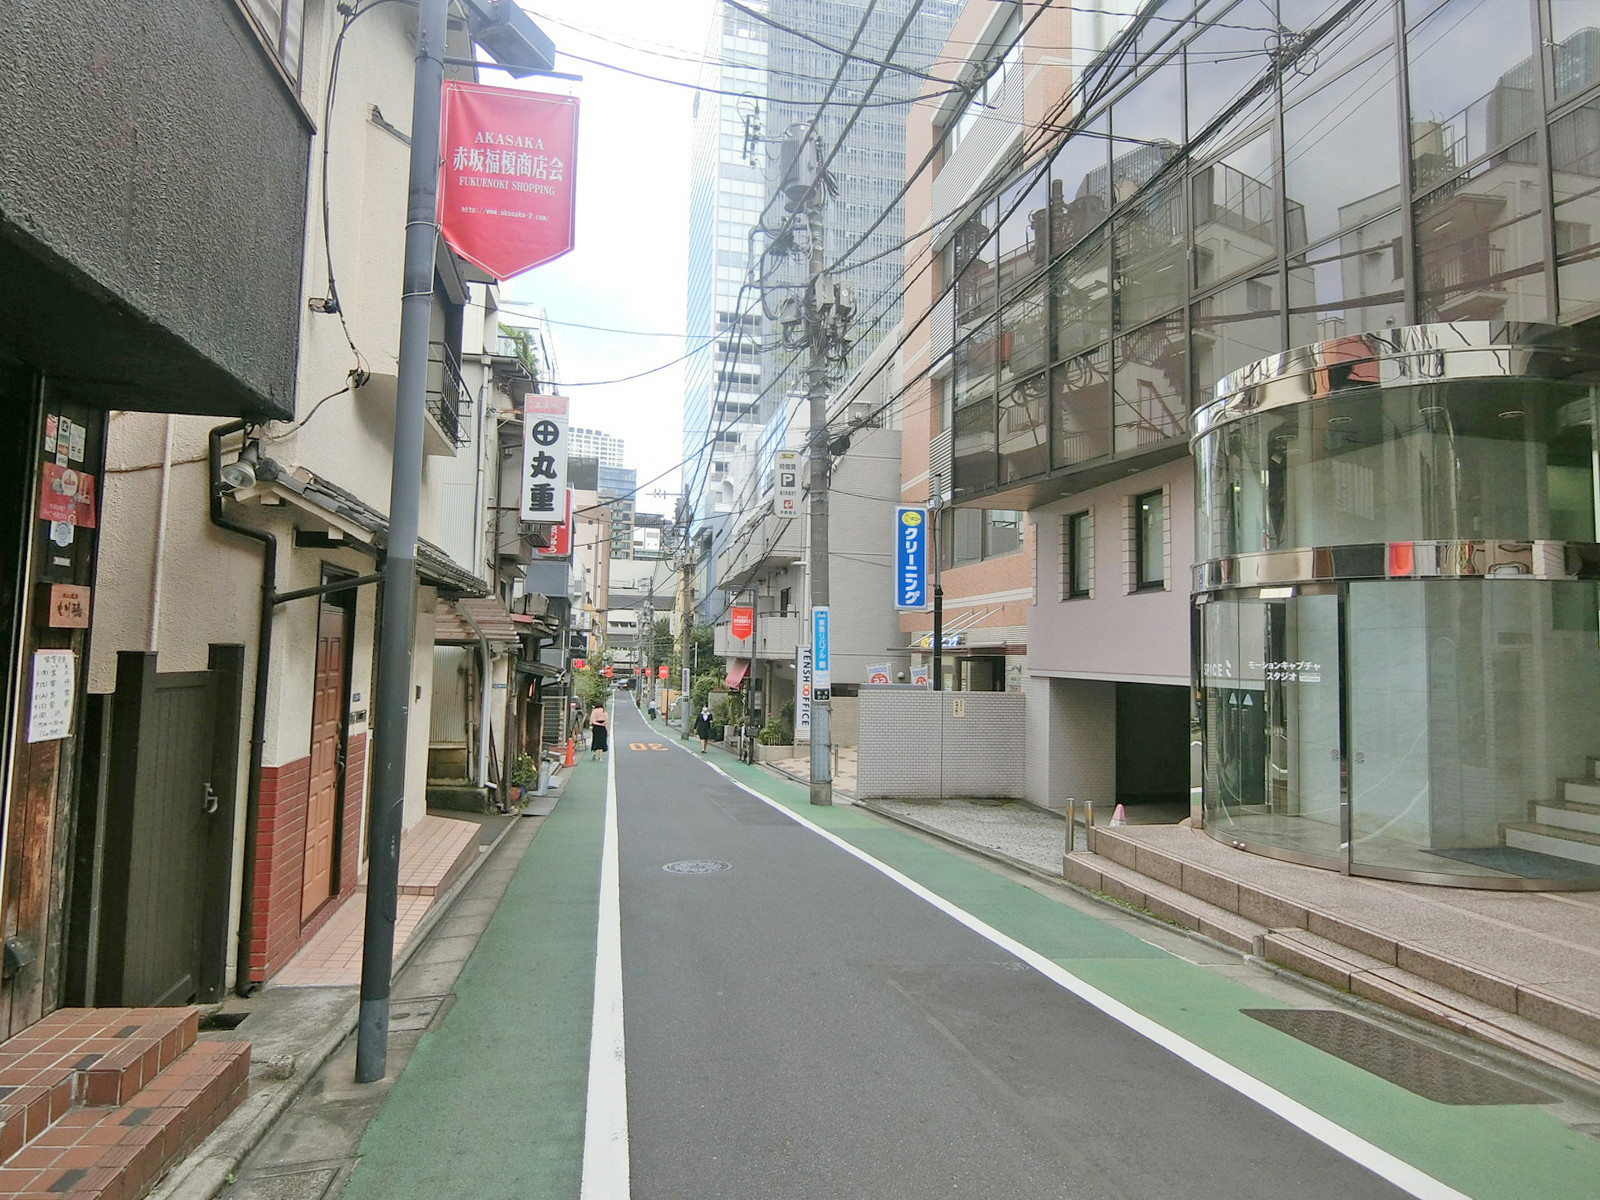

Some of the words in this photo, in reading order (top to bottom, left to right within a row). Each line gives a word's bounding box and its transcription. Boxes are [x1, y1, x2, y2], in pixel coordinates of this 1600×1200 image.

[474, 131, 544, 150] AKASAKA
[459, 176, 509, 190] FUKUENOKI
[511, 180, 555, 196] SHOPPING
[529, 450, 557, 512] 丸重
[782, 473, 794, 486] P
[904, 527, 921, 604] クリーニング
[1248, 660, 1321, 671] モーションキャプチャ
[1266, 672, 1297, 681] スタジオ
